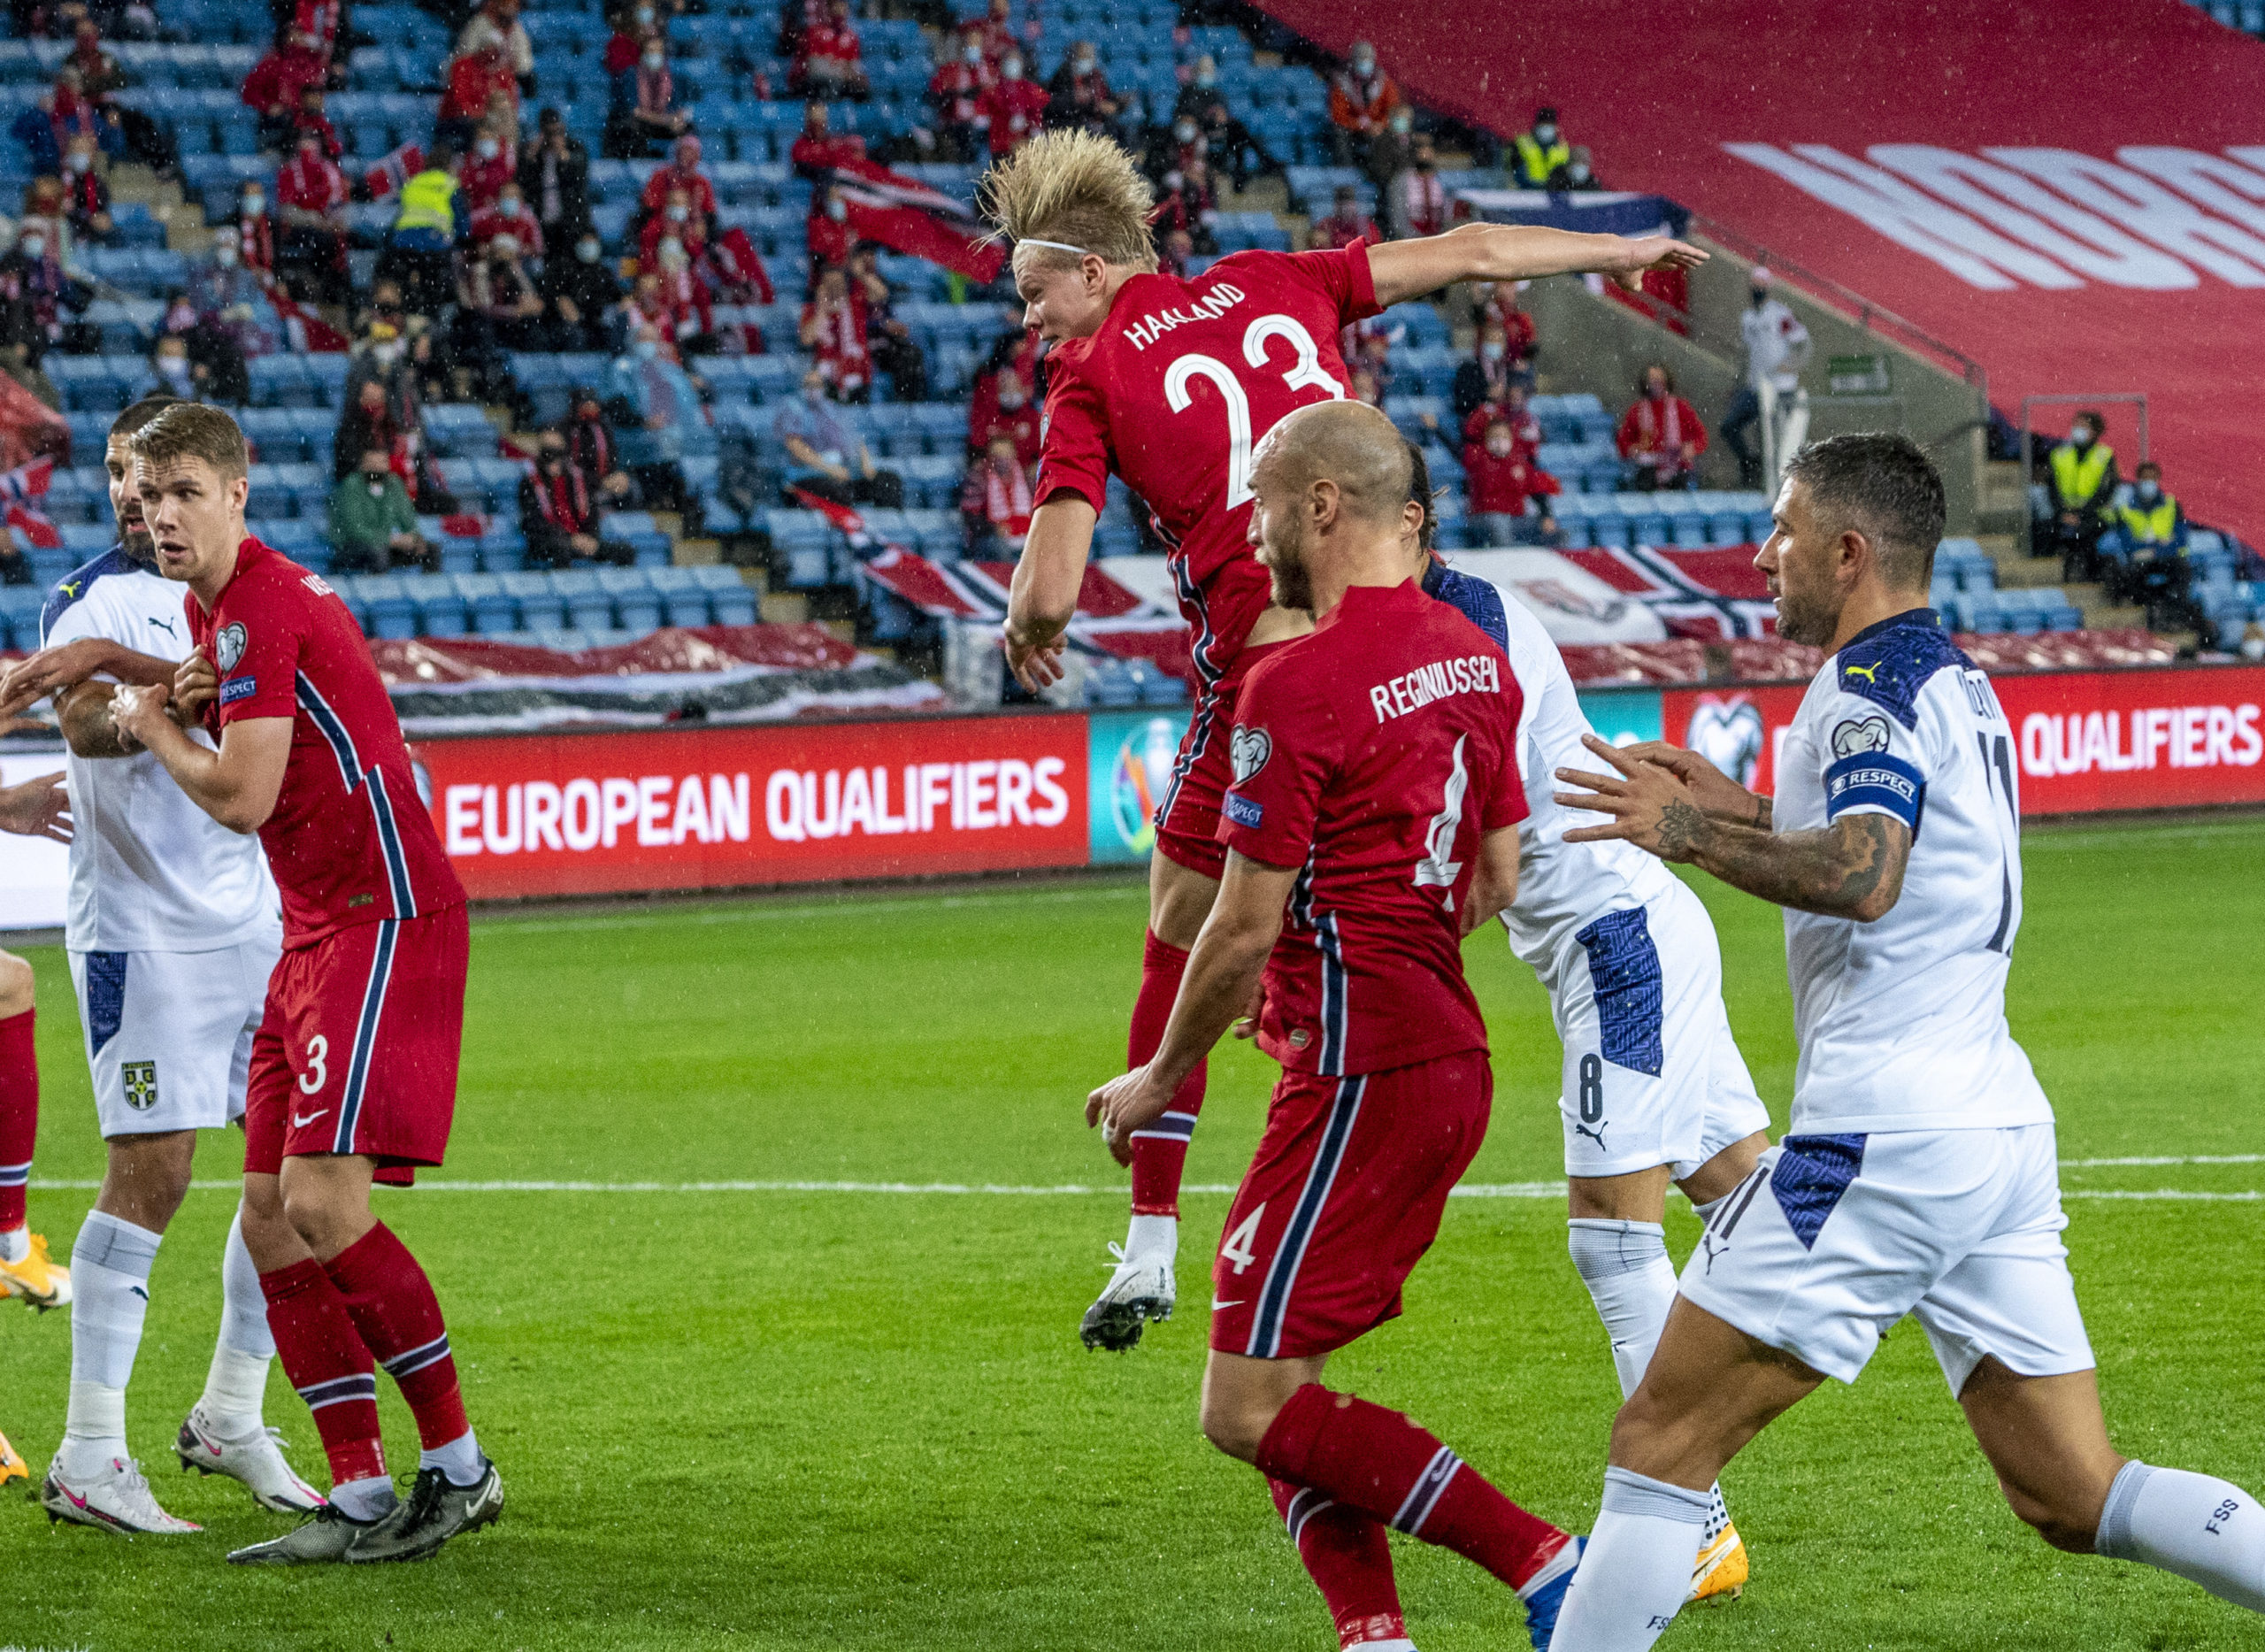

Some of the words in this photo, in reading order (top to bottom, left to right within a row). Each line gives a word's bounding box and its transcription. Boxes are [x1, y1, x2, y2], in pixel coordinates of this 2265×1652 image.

[1123, 282, 1246, 351] HAALAND
[1163, 313, 1345, 511] 23
[2021, 703, 2263, 778] QUALIFIERS
[445, 772, 750, 856] EUROPEAN
[765, 756, 1070, 842] QUALIFIERS
[1849, 772, 1916, 797] RESPECT
[299, 1034, 328, 1095] 3
[1579, 1053, 1603, 1124] 8
[1220, 1201, 1268, 1275] 4
[1709, 1165, 1770, 1241] 11
[2205, 1499, 2239, 1536] FSS
